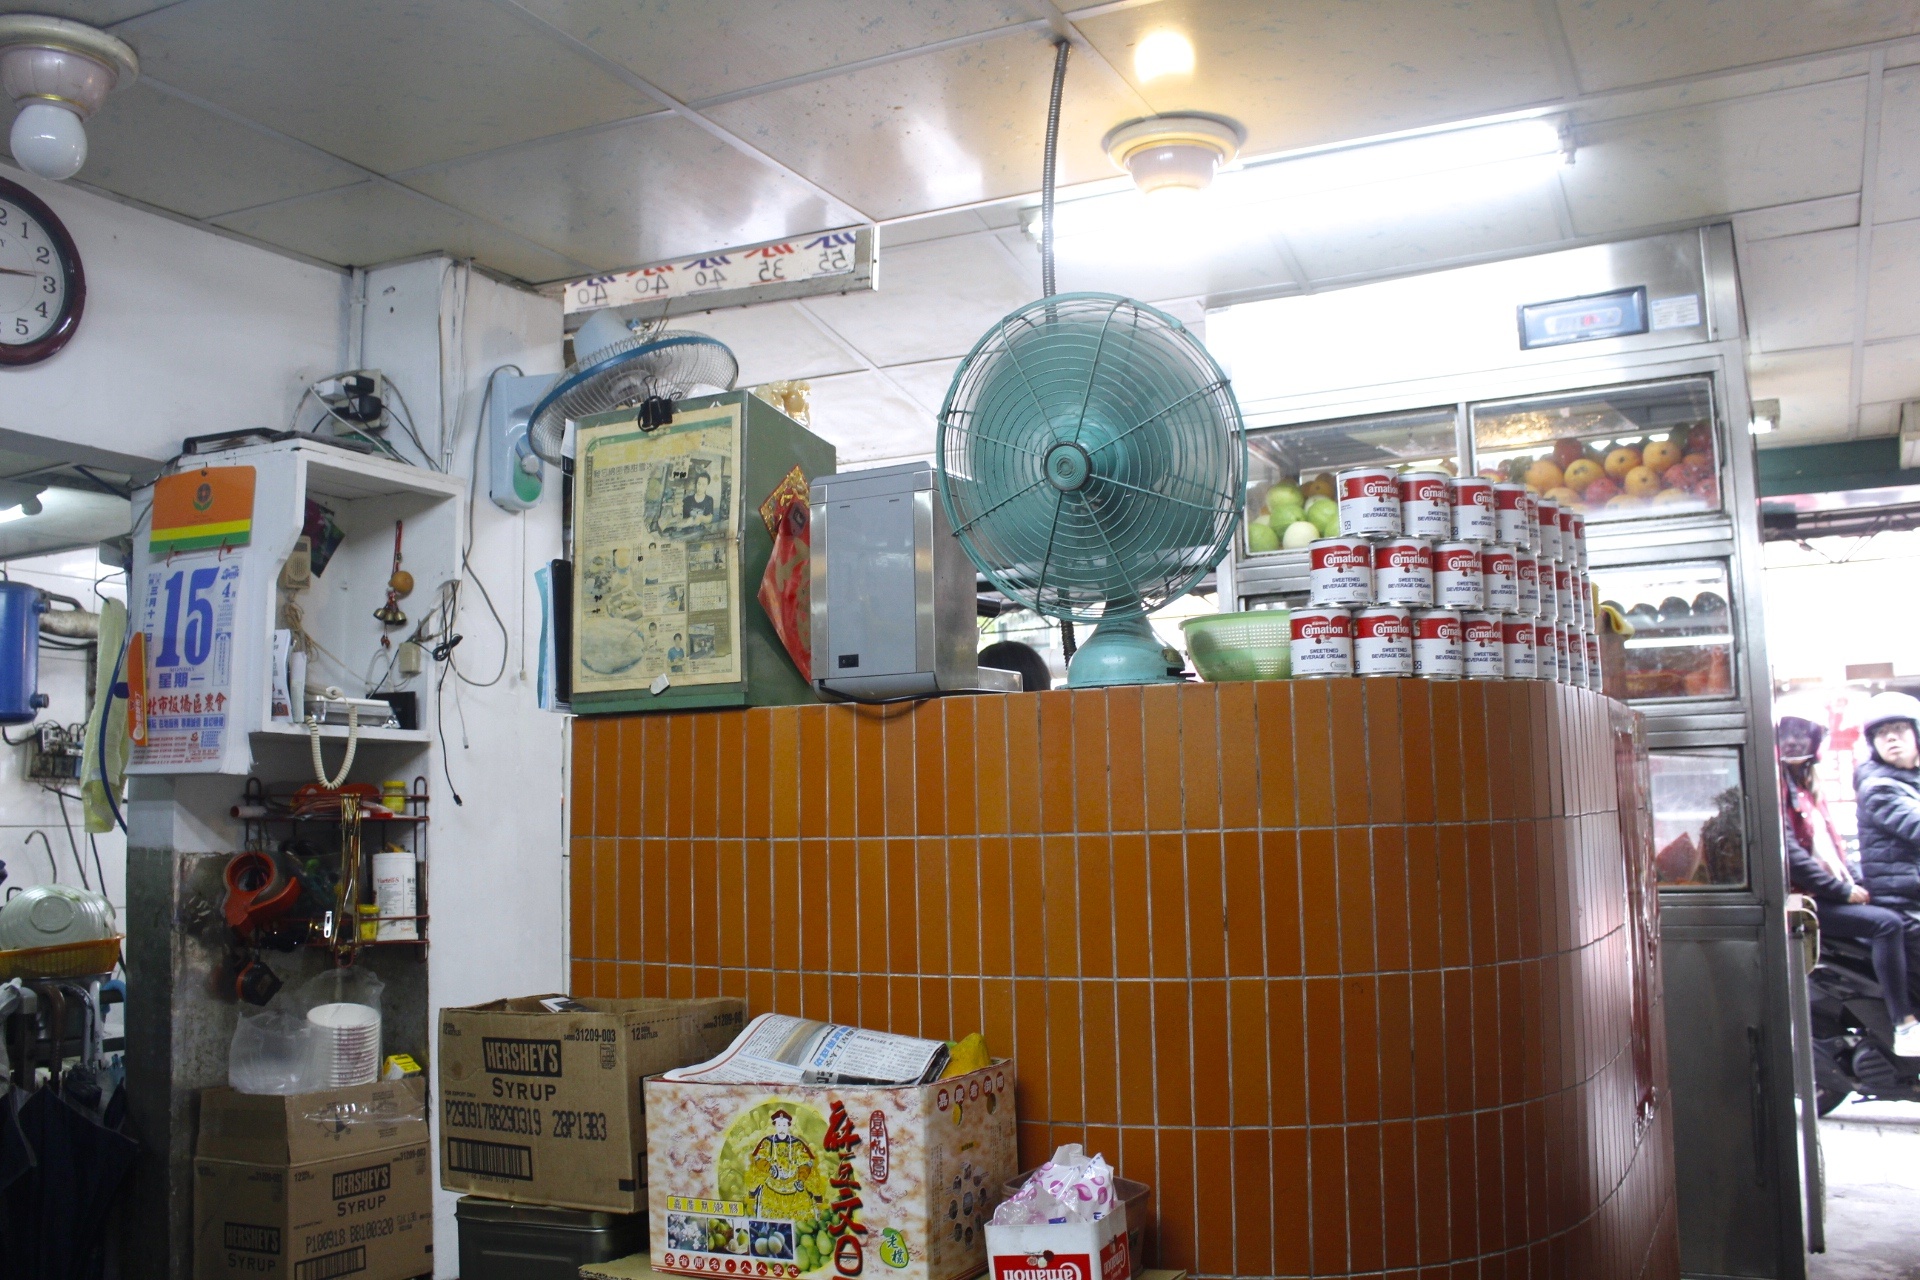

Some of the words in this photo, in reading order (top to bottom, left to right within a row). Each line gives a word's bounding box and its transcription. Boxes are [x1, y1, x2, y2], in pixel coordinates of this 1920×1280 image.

[21, 221, 29, 239] 1
[36, 246, 50, 264] 2
[43, 276, 56, 294] 3
[35, 301, 48, 318] 4
[15, 317, 29, 335] 5
[1323, 553, 1364, 567] Carnation
[1390, 552, 1429, 567] Carnation
[155, 566, 220, 667] 15
[1302, 624, 1343, 638] Carnation
[1373, 622, 1409, 637] Carnation
[158, 672, 205, 689] 星期一
[575, 1028, 616, 1043] 31209-003
[631, 1028, 641, 1041] 12
[485, 1040, 560, 1074] HERSHEY'S
[491, 1076, 557, 1102] SYRUP
[335, 1167, 389, 1196] HERSHEY'S
[337, 1195, 387, 1217] SYRUP
[226, 1223, 280, 1255] HERSHEY'S
[228, 1253, 276, 1272] SYRUP
